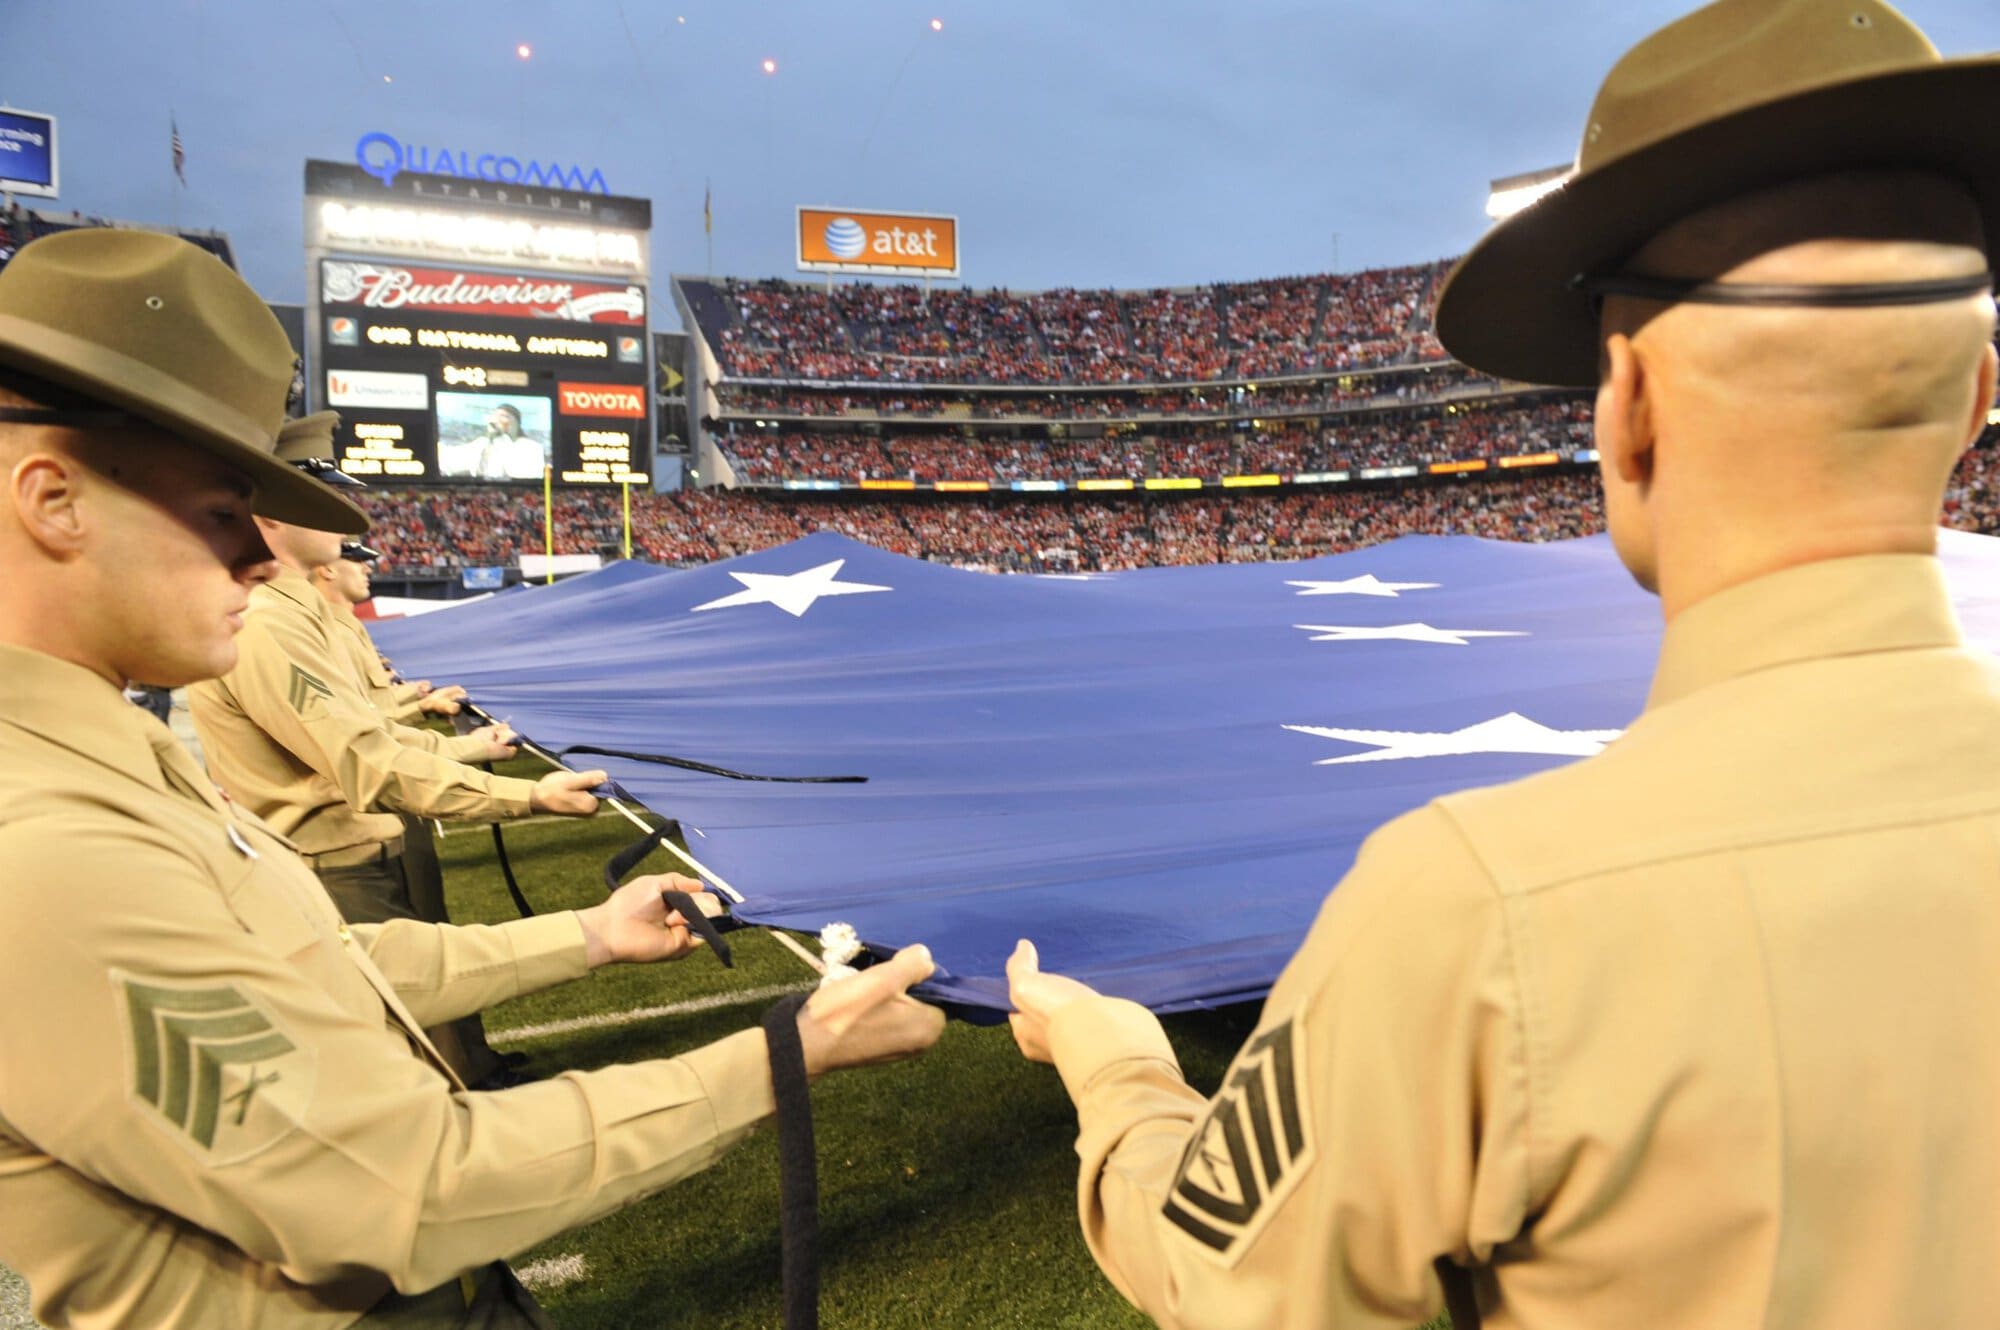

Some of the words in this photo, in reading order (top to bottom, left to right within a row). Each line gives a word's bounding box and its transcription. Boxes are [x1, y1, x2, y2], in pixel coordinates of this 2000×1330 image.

[412, 180, 592, 210] STADIUM
[872, 226, 938, 257] at&t
[356, 270, 573, 309] Budweiser
[417, 329, 521, 353] NATIONAL
[526, 336, 608, 357] ANTHEM
[562, 391, 642, 411] TOYOTA
